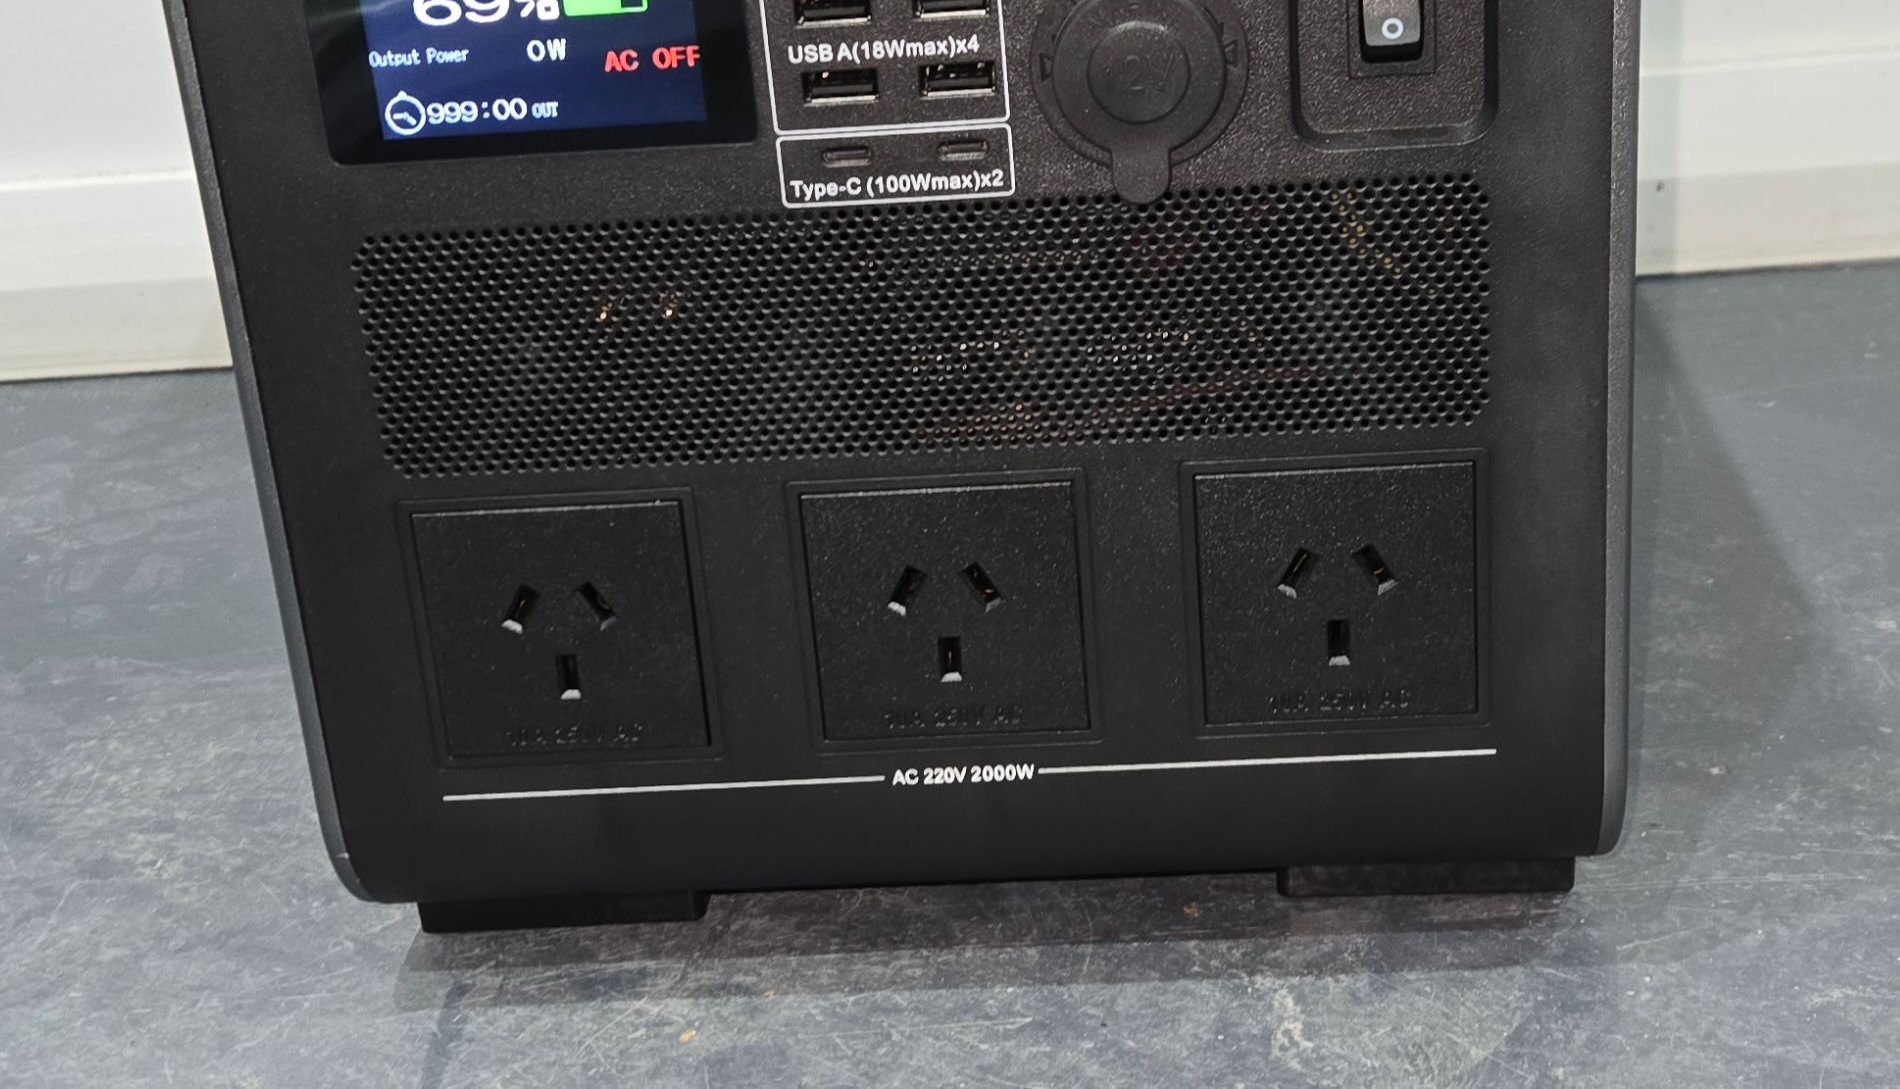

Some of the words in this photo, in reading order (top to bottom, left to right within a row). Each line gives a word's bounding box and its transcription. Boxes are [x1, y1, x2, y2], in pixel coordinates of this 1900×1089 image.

[368, 48, 421, 68] Output
[426, 46, 470, 65] Power
[605, 50, 638, 72] AC
[652, 45, 702, 70] OFF
[787, 44, 834, 64] USB
[426, 97, 528, 125] 999:00
[531, 100, 559, 119] OUT
[789, 176, 862, 200] Type-C
[865, 169, 1005, 197] (100Wmax)x2
[892, 768, 919, 786] AC
[923, 765, 967, 785] 220V
[970, 763, 1035, 784] 2000W
